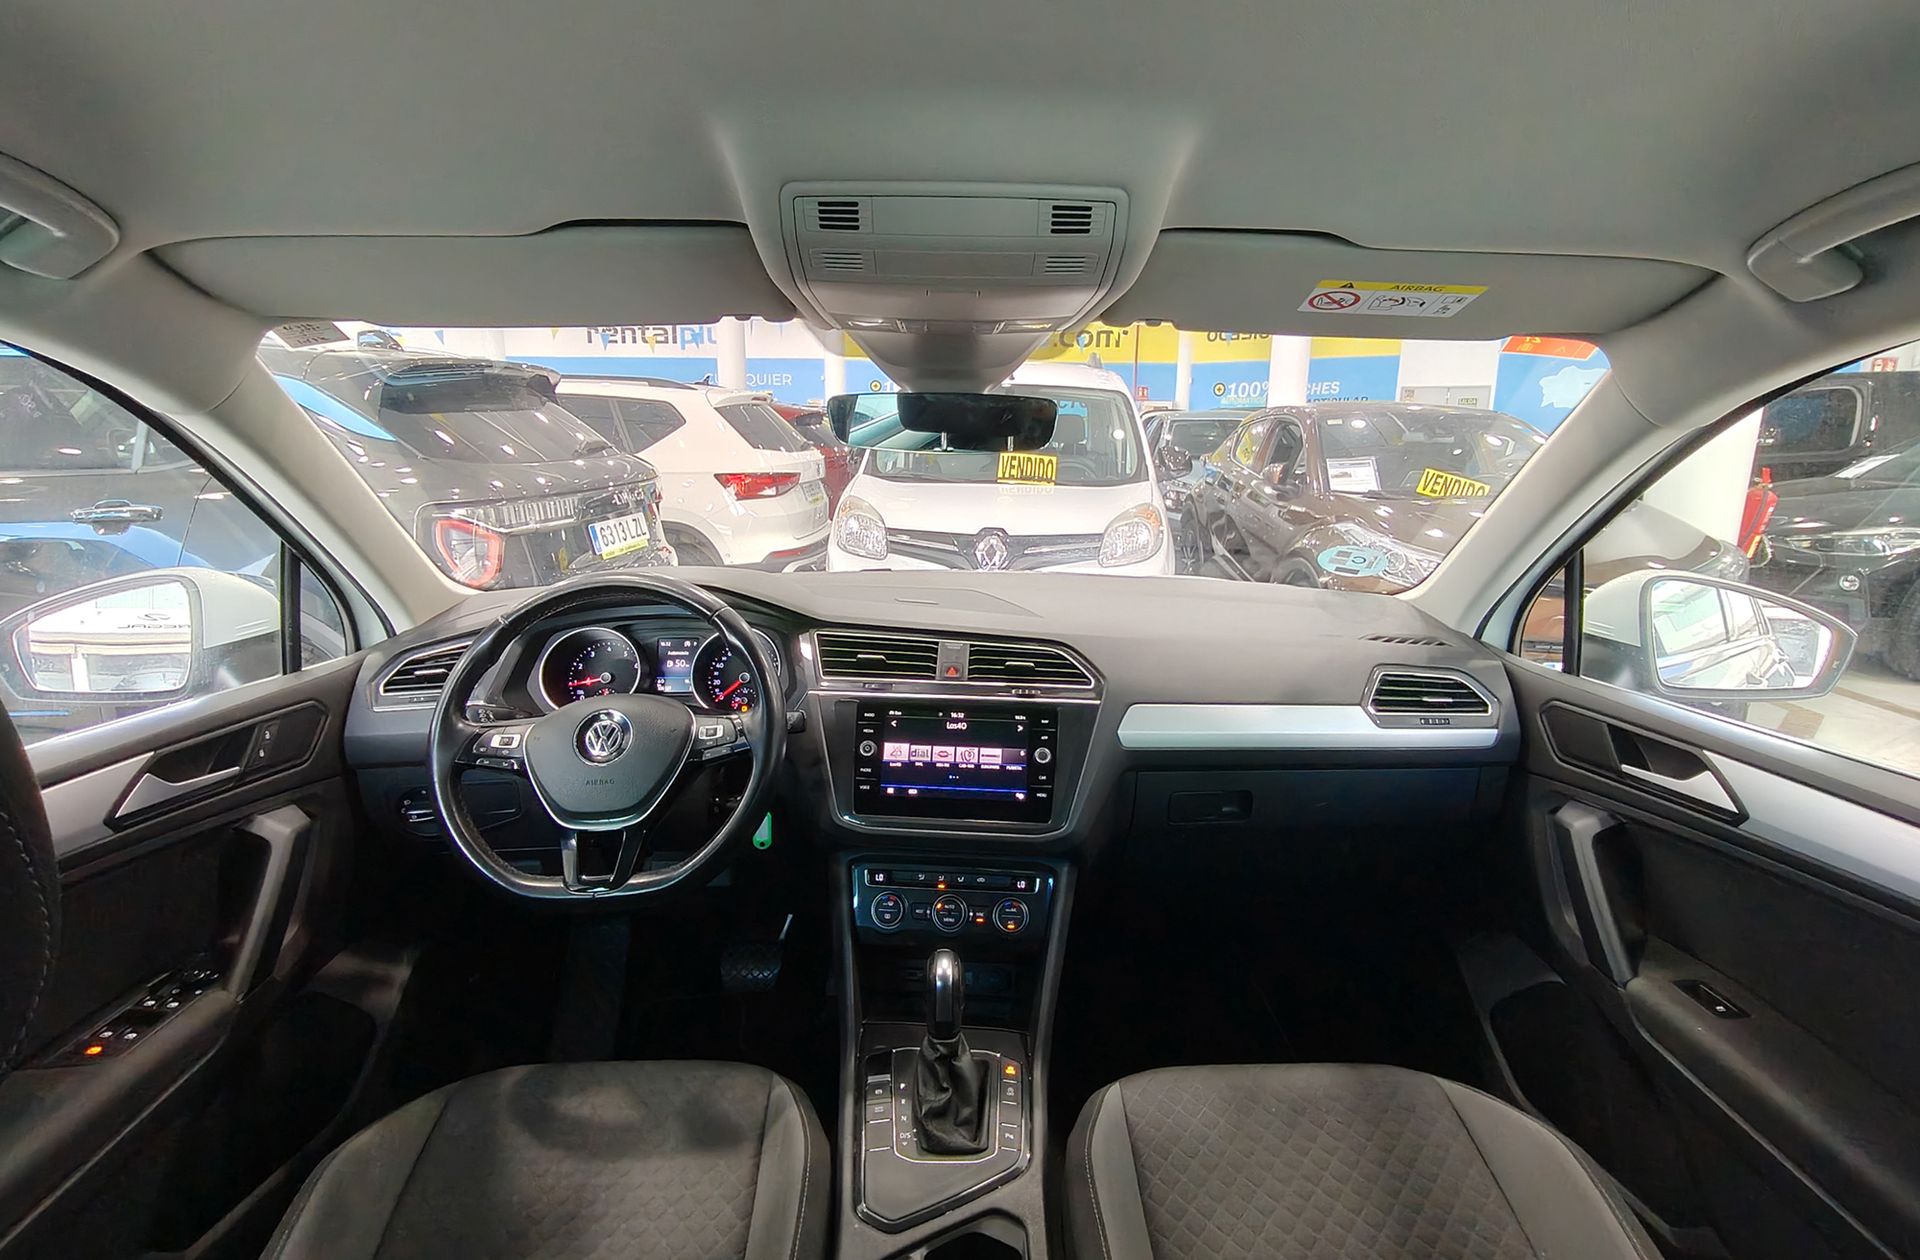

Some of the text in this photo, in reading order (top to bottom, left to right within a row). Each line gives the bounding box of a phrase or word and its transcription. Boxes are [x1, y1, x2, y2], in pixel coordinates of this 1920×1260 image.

[1391, 285, 1446, 293] AIRBAG
[586, 325, 717, 350] rentalplu
[1002, 455, 1054, 483] VENDIDO
[1423, 471, 1486, 496] VENDIDO
[599, 517, 647, 547] 6313 LZL
[946, 721, 968, 730] Los40
[910, 748, 929, 759] dial
[875, 873, 1026, 888] LO LO
